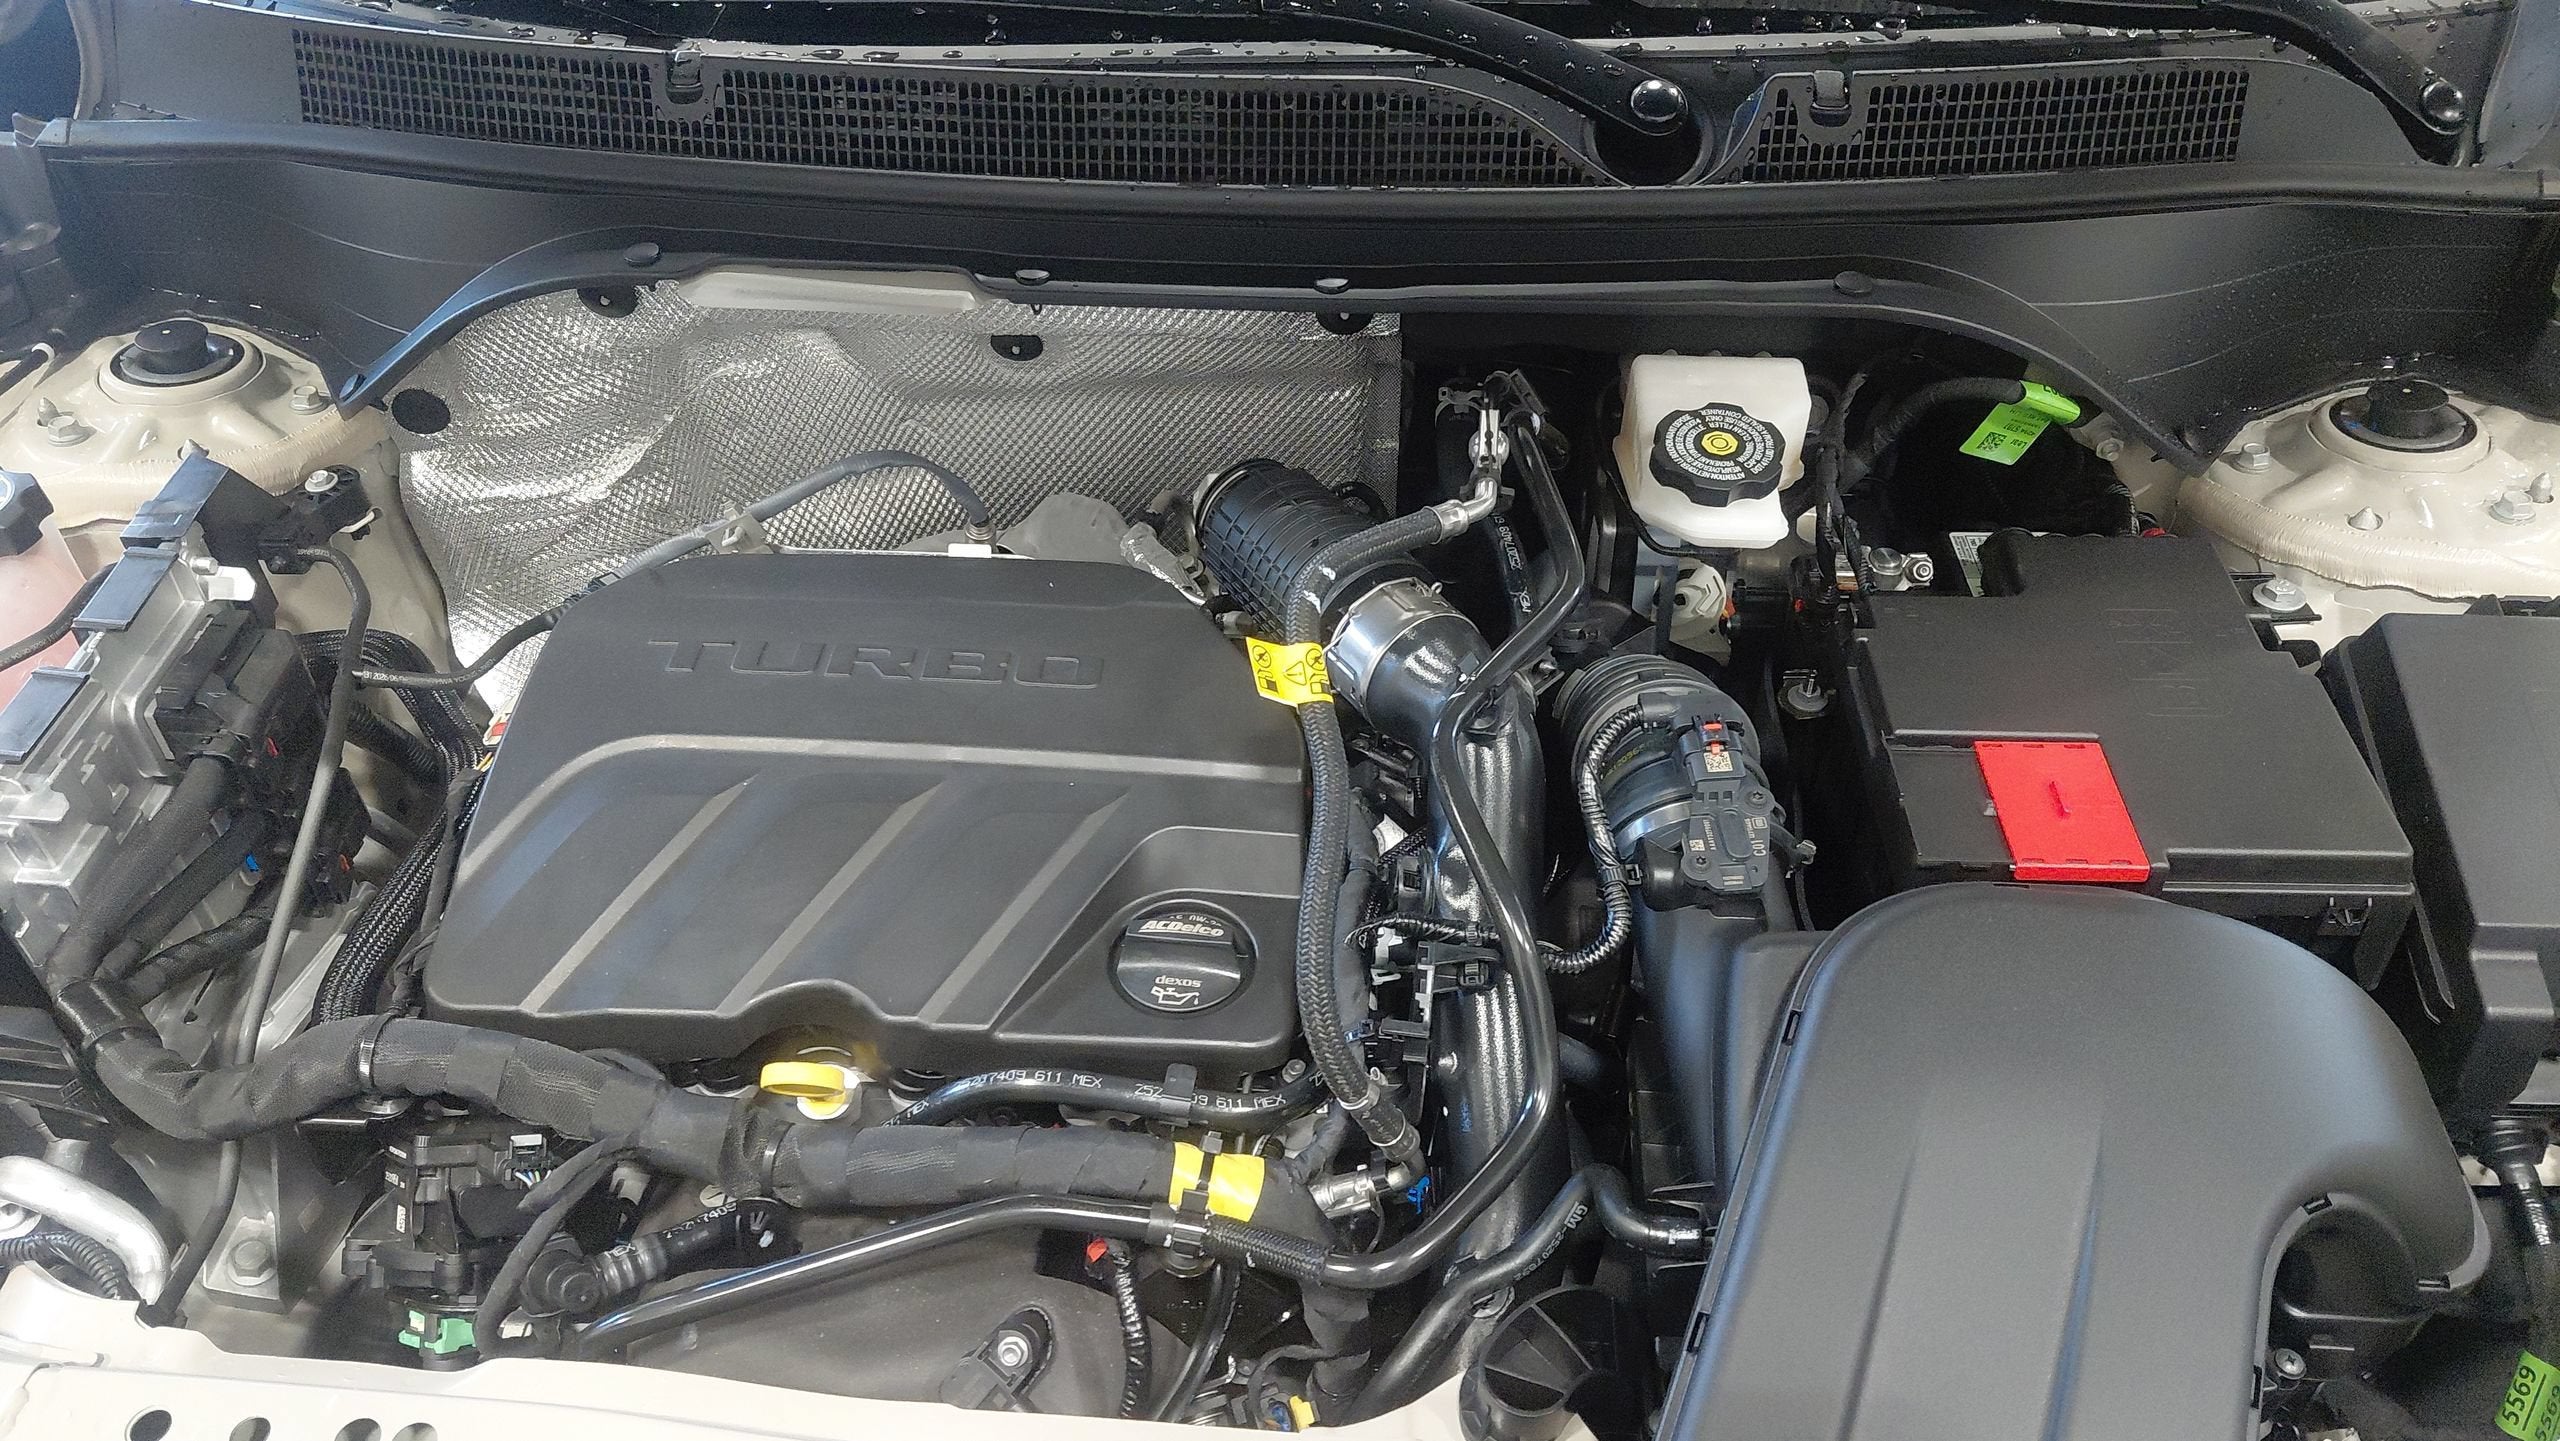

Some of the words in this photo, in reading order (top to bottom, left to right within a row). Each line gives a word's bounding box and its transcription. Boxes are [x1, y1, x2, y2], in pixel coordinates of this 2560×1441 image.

[1740, 415, 1765, 431] SEALED
[1731, 426, 1752, 440] CLEAN
[647, 638, 1104, 690] TURBO
[1751, 839, 1767, 856] C01
[1139, 920, 1225, 938] ACDelco
[1155, 974, 1204, 988] dexos
[1034, 1071, 1062, 1083] 611
[1072, 1073, 1104, 1089] MEX
[1215, 1095, 1242, 1109] 611
[1253, 1093, 1288, 1109] MEX
[604, 1242, 636, 1257] MEX
[2502, 1365, 2537, 1426] 5569
